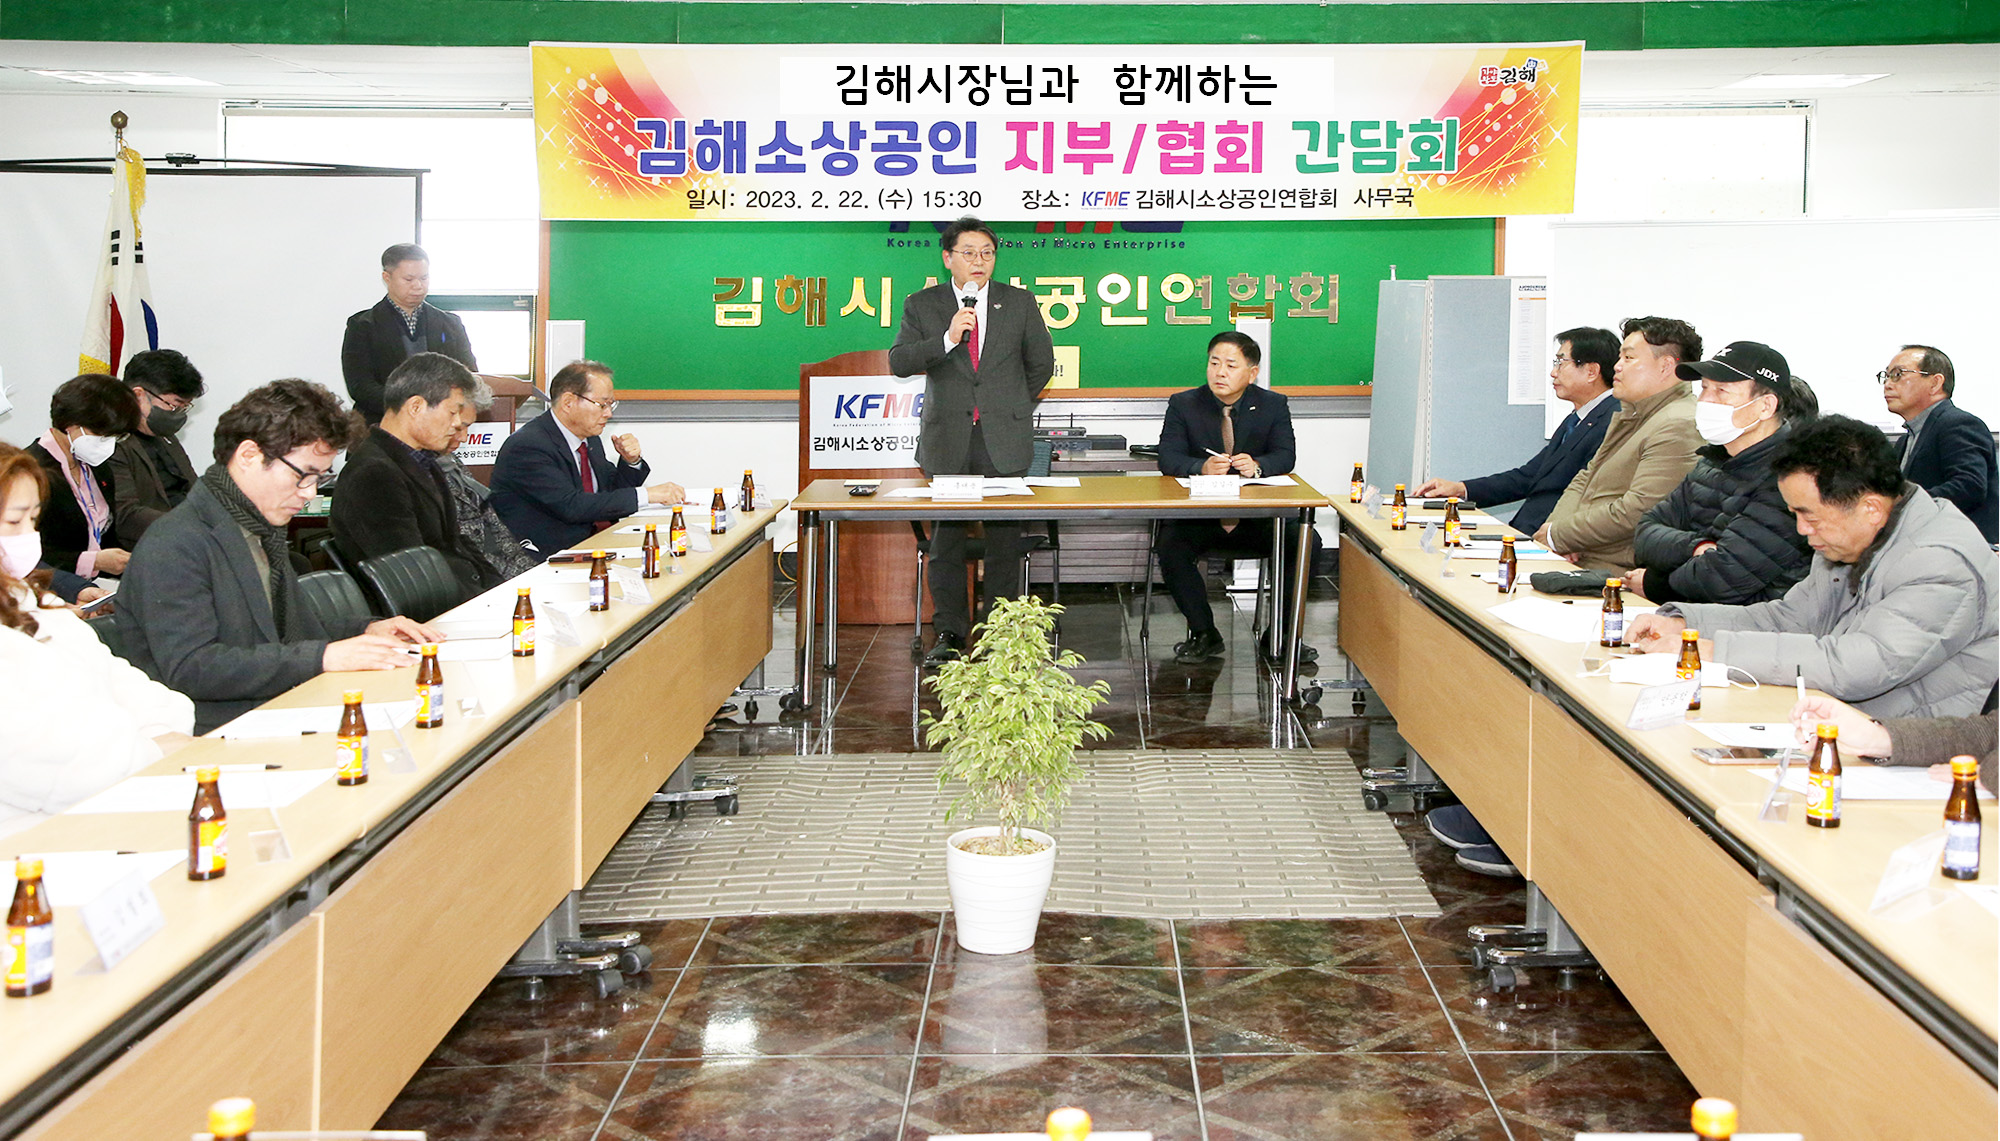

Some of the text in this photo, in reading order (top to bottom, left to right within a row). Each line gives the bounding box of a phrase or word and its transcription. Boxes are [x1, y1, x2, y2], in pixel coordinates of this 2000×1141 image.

[836, 63, 1279, 107] 김해시장님과 함께하는
[1500, 66, 1537, 84] 김해
[636, 117, 1459, 177] 김해소상공인 지부/협회 간담회
[686, 189, 983, 211] 일시: 2023. 2. 22. (수) 15:30
[1021, 188, 1416, 210] 장소: KFME 김해시소상공인연합회 사무국
[887, 238, 931, 247] Korea
[1104, 239, 1186, 250] Enterprise
[713, 272, 1339, 328] 김해시공인연합회
[1756, 367, 1780, 383] JDX
[466, 433, 493, 444] ME
[813, 436, 921, 451] 김해시소상공인
